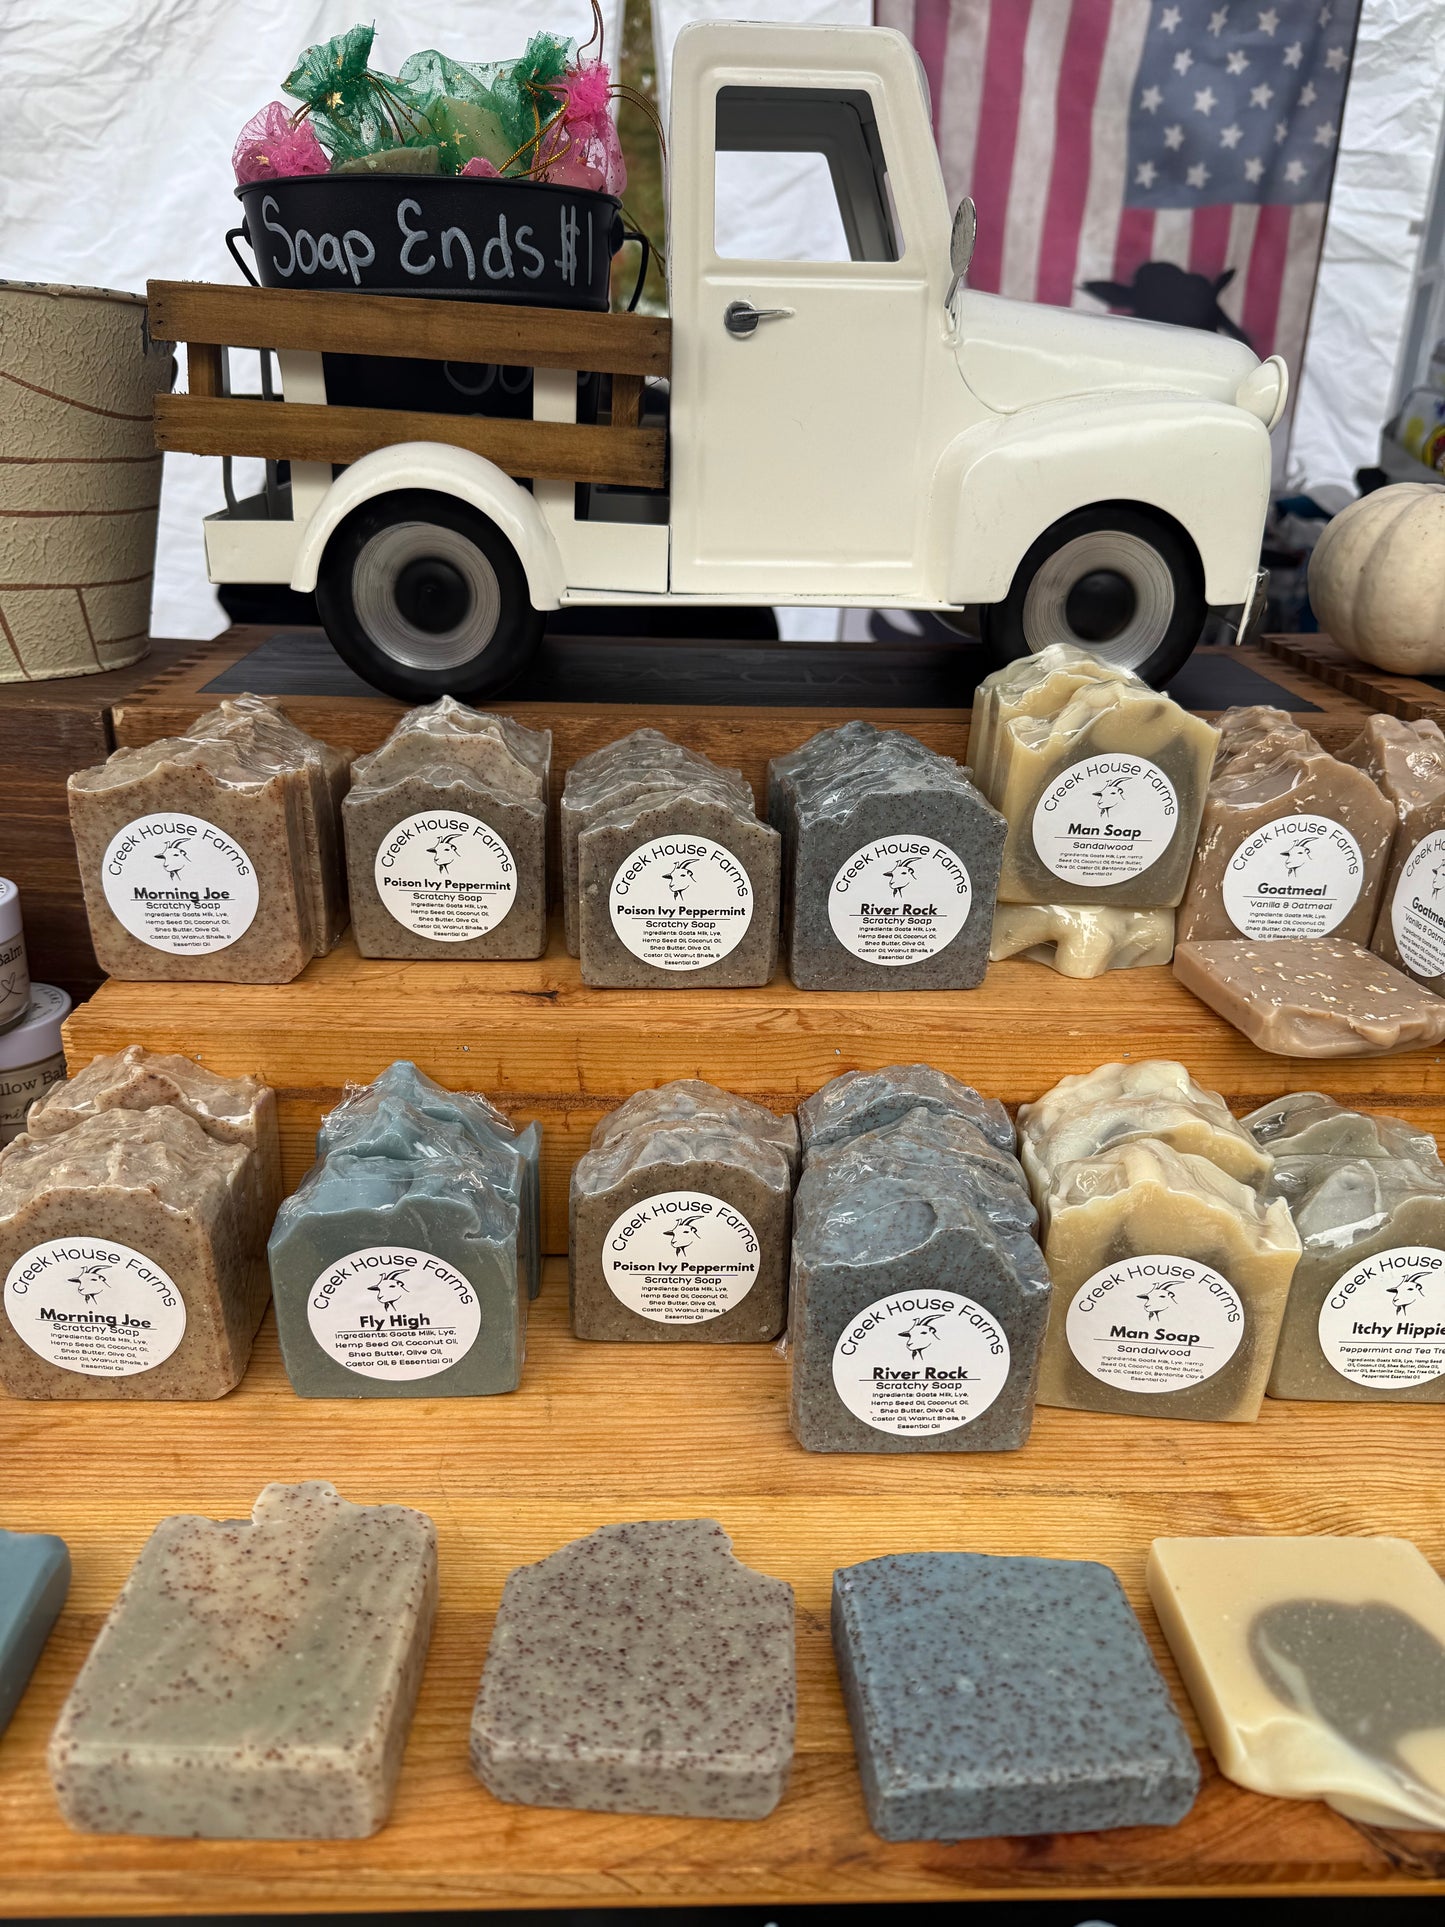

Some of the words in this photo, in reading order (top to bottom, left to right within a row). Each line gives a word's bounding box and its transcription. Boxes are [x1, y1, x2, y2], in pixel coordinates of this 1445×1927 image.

[262, 195, 376, 286] Soap
[397, 198, 545, 280] Ends
[554, 204, 592, 286] $1
[1044, 772, 1084, 812] Creek
[1086, 762, 1142, 777] House
[1143, 769, 1175, 815] Farms
[1068, 823, 1100, 836] Man
[1104, 824, 1142, 840] Soap
[109, 835, 140, 876] Creek
[139, 822, 197, 840] House
[202, 829, 250, 876] Farms
[381, 828, 415, 867] Creek
[414, 819, 469, 833] House
[473, 826, 512, 872] Farms
[1072, 842, 1133, 851] Sandalwood
[1233, 832, 1272, 871] Creek
[1274, 822, 1327, 837] House
[1329, 830, 1359, 875] Farms
[836, 853, 874, 892] Creek
[875, 843, 930, 858] House
[933, 849, 967, 894] Farms
[1407, 843, 1432, 877] Creek
[615, 855, 651, 895] Creek
[652, 844, 707, 859] House
[710, 850, 748, 897] Farms
[384, 877, 421, 887] Poison
[425, 879, 442, 890] Ivy
[445, 880, 511, 891] Peppermint
[1258, 882, 1327, 896] Goatmeal
[134, 887, 200, 904] Morning
[203, 887, 230, 899] Joe
[413, 892, 455, 902] Scratchy
[458, 894, 483, 903] Soap
[146, 902, 191, 910] Scratchy
[194, 902, 220, 910] Soap
[617, 905, 655, 915] Poison
[658, 906, 676, 917] Ivy
[679, 906, 746, 918] Peppermint
[861, 903, 899, 914] River
[903, 903, 938, 915] Rock
[1250, 900, 1280, 908] Vanilla
[1292, 902, 1332, 910] Oatmeal
[645, 920, 688, 929] Scratchy
[691, 921, 716, 929] Soap
[862, 917, 905, 925] Scratchy
[42, 1064, 67, 1085] Bal
[612, 1212, 651, 1251] Creek
[652, 1201, 713, 1216] House
[716, 1207, 758, 1253] Farms
[613, 1261, 655, 1271] Poison
[659, 1262, 677, 1274] Ivy
[681, 1262, 755, 1274] Peppermint
[12, 1256, 53, 1295] Creek
[52, 1248, 121, 1264] House
[126, 1258, 176, 1307] Farms
[314, 1268, 352, 1310] Creek
[351, 1255, 417, 1272] House
[423, 1259, 473, 1305] Farms
[644, 1276, 691, 1285] Scratchy
[694, 1277, 721, 1285] Soap
[1331, 1267, 1377, 1309] Creek
[1379, 1256, 1442, 1272] House
[1079, 1273, 1125, 1312] Creek
[1127, 1264, 1195, 1279] House
[1199, 1273, 1240, 1323] Farms
[40, 1307, 117, 1327] Morning
[122, 1314, 151, 1328] Joe
[360, 1315, 385, 1331] Fly
[390, 1313, 430, 1330] High
[53, 1323, 107, 1334] Scratchy
[110, 1327, 140, 1337] Soap
[841, 1311, 885, 1355] Creek
[886, 1299, 954, 1316] House
[958, 1304, 1004, 1355] Farms
[1110, 1325, 1148, 1339] Man
[1154, 1328, 1200, 1346] Soap
[1353, 1322, 1393, 1338] Itchy
[1117, 1345, 1191, 1357] Sandalwood
[1340, 1346, 1393, 1354] Peppermint
[873, 1367, 920, 1379] River
[925, 1366, 968, 1379] Rock
[876, 1382, 929, 1390] Scratchy
[932, 1382, 962, 1390] Soap
